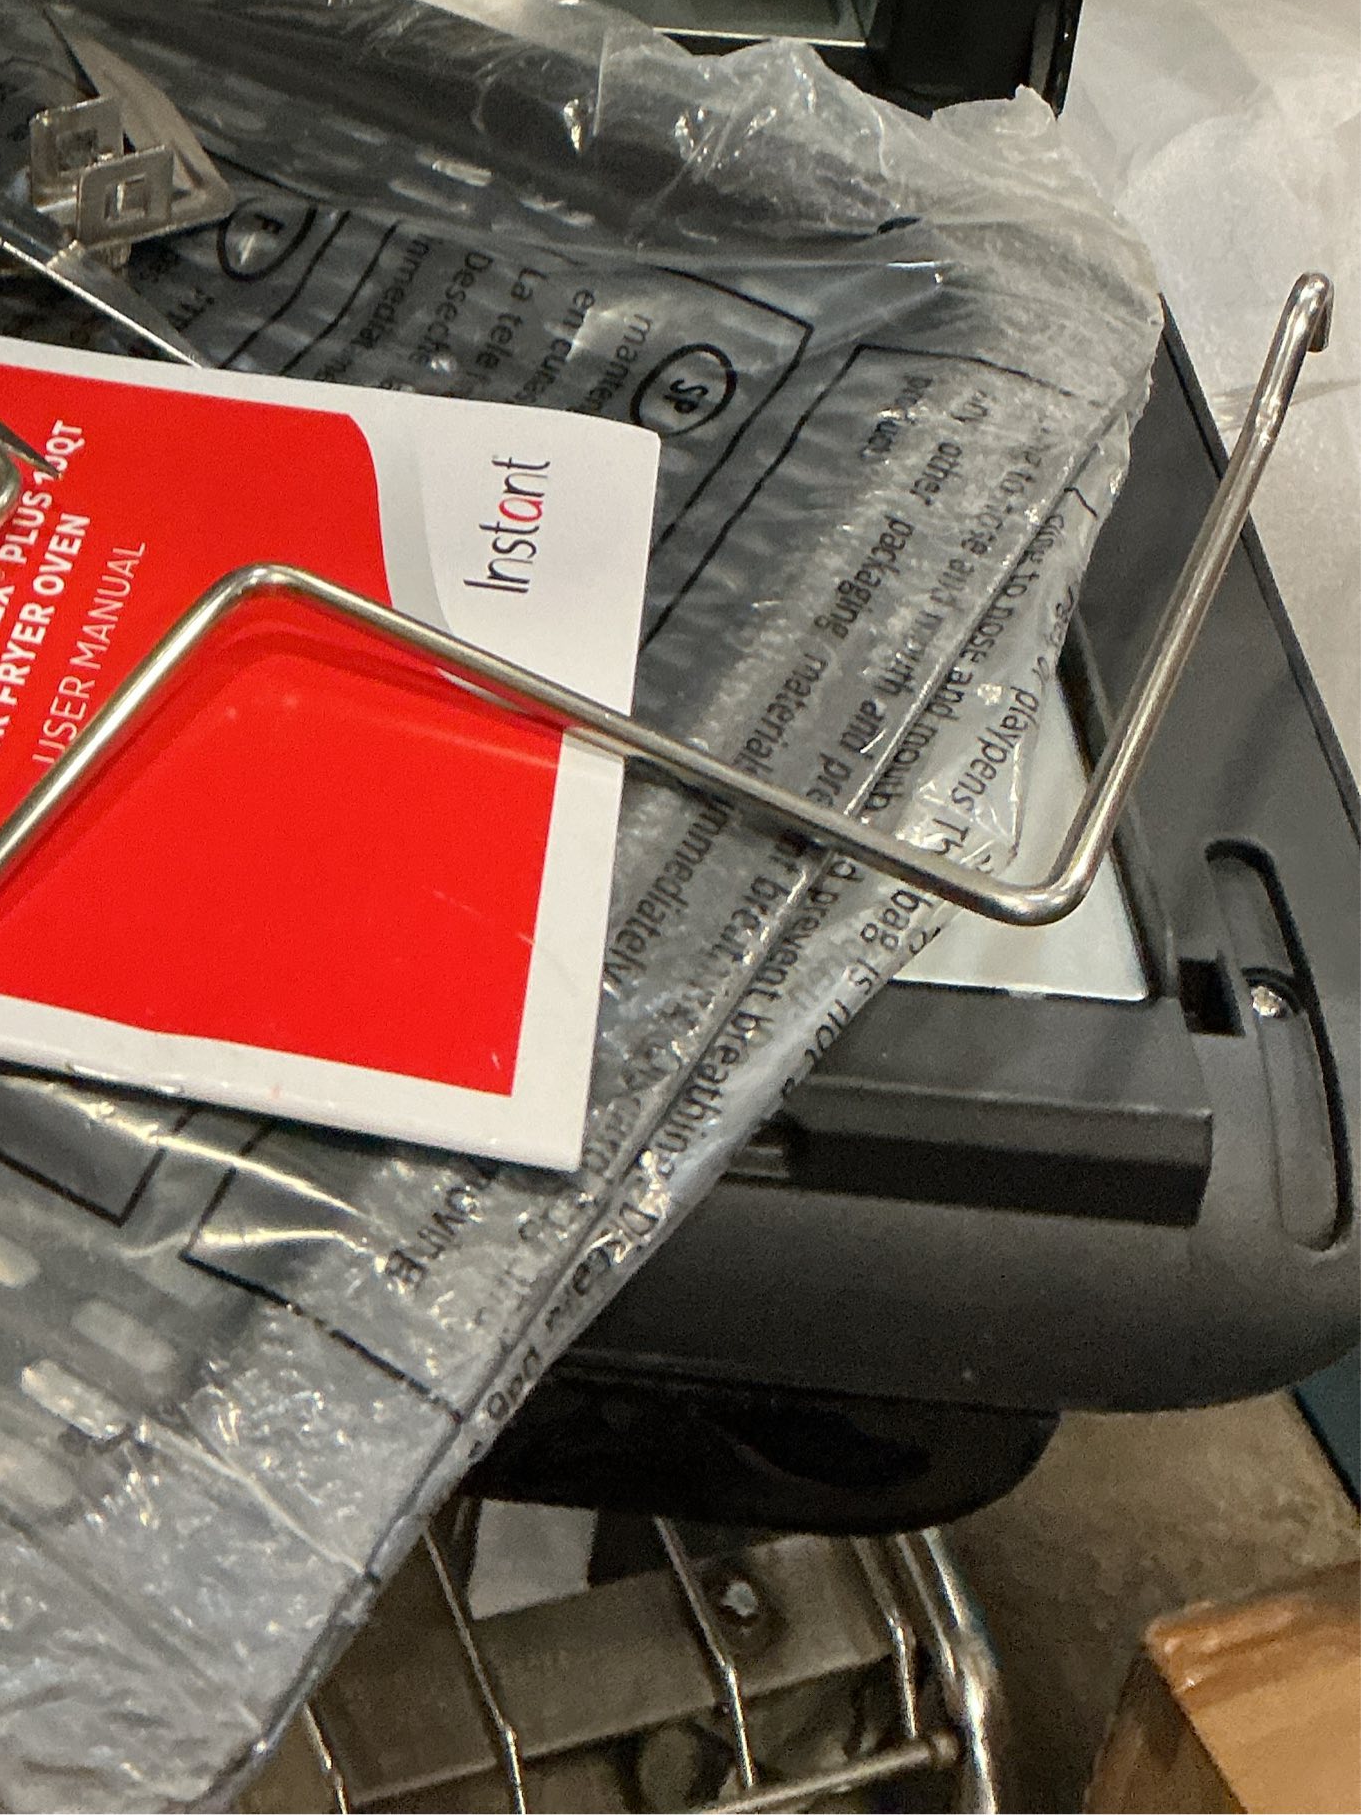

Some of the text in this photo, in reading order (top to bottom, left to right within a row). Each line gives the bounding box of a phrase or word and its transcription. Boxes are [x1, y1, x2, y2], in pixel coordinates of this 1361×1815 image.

[668, 375, 711, 415] SP
[463, 455, 550, 594] Instant
[906, 439, 963, 508] other
[32, 512, 91, 597] OVEN
[812, 514, 916, 641] packaging
[32, 542, 146, 764] USER MANUAL
[947, 687, 1041, 812] playpens
[858, 886, 934, 954] bag
